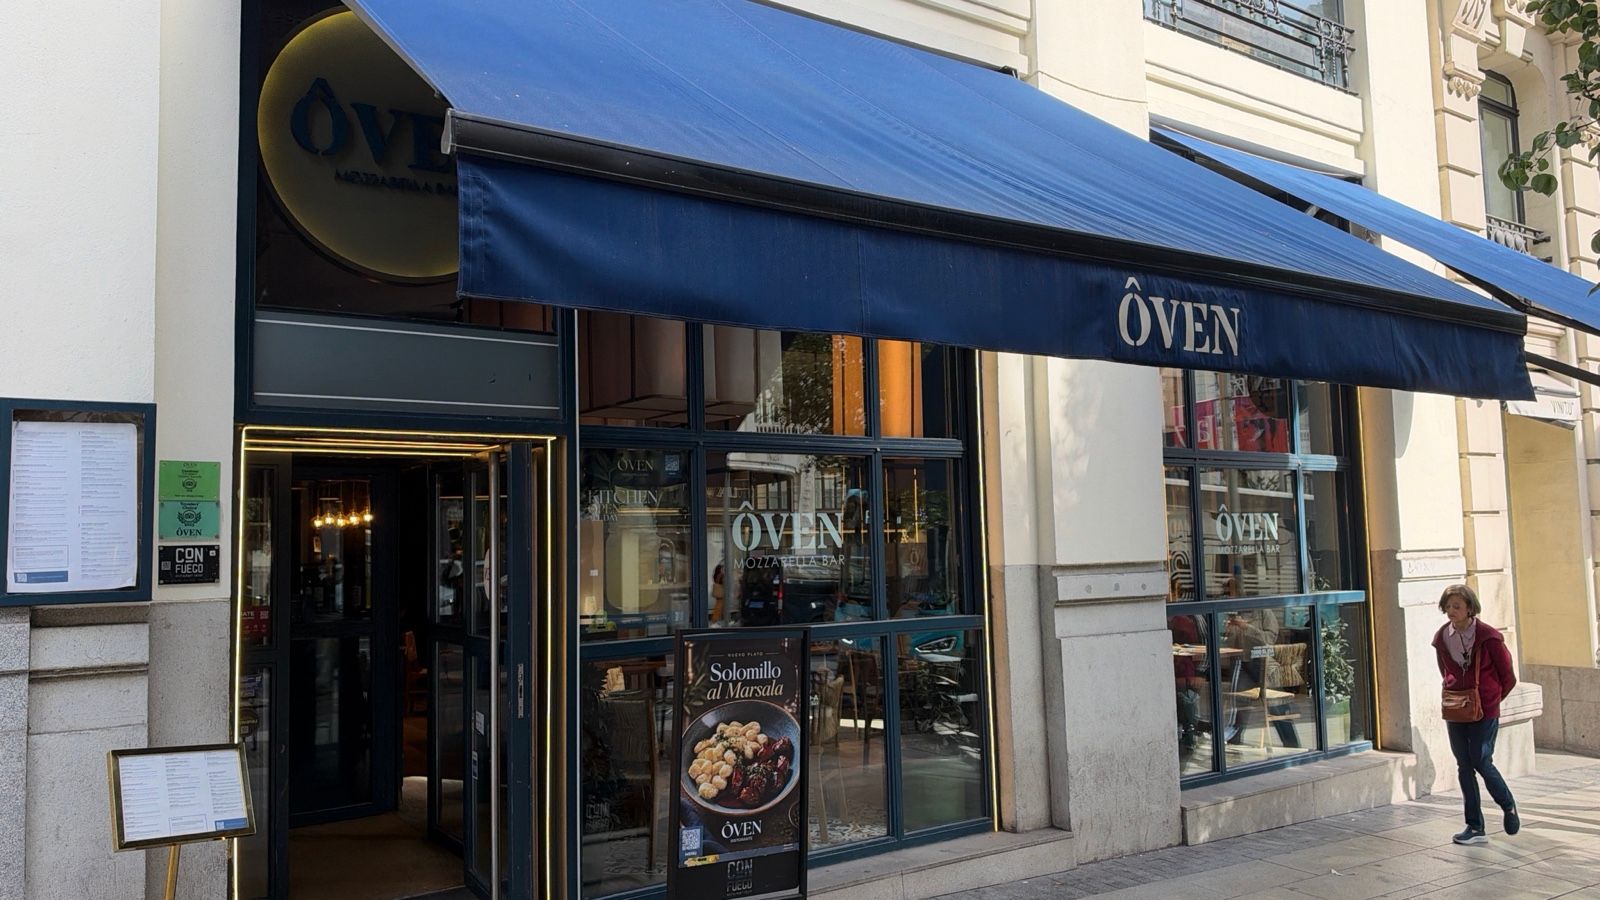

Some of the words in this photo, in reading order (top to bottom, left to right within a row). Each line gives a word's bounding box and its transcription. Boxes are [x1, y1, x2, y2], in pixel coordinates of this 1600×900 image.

[291, 77, 451, 173] ÔVE
[1118, 276, 1240, 356] ÔVEN
[587, 489, 659, 504] KITCHEN
[732, 500, 844, 552] ÔVEN
[1215, 503, 1279, 541] ÔVEN
[176, 527, 203, 537] ÔVEN
[175, 547, 204, 563] CON
[1218, 545, 1265, 554] MOZZARELLA
[1266, 544, 1281, 553] BAR
[175, 563, 204, 574] FUEGO
[733, 555, 817, 569] MOZZARELLA
[822, 554, 845, 567] BAR
[710, 660, 782, 682] Solomillo
[706, 681, 723, 700] al
[725, 679, 784, 699] Marsala
[721, 820, 762, 839] ÔVEN
